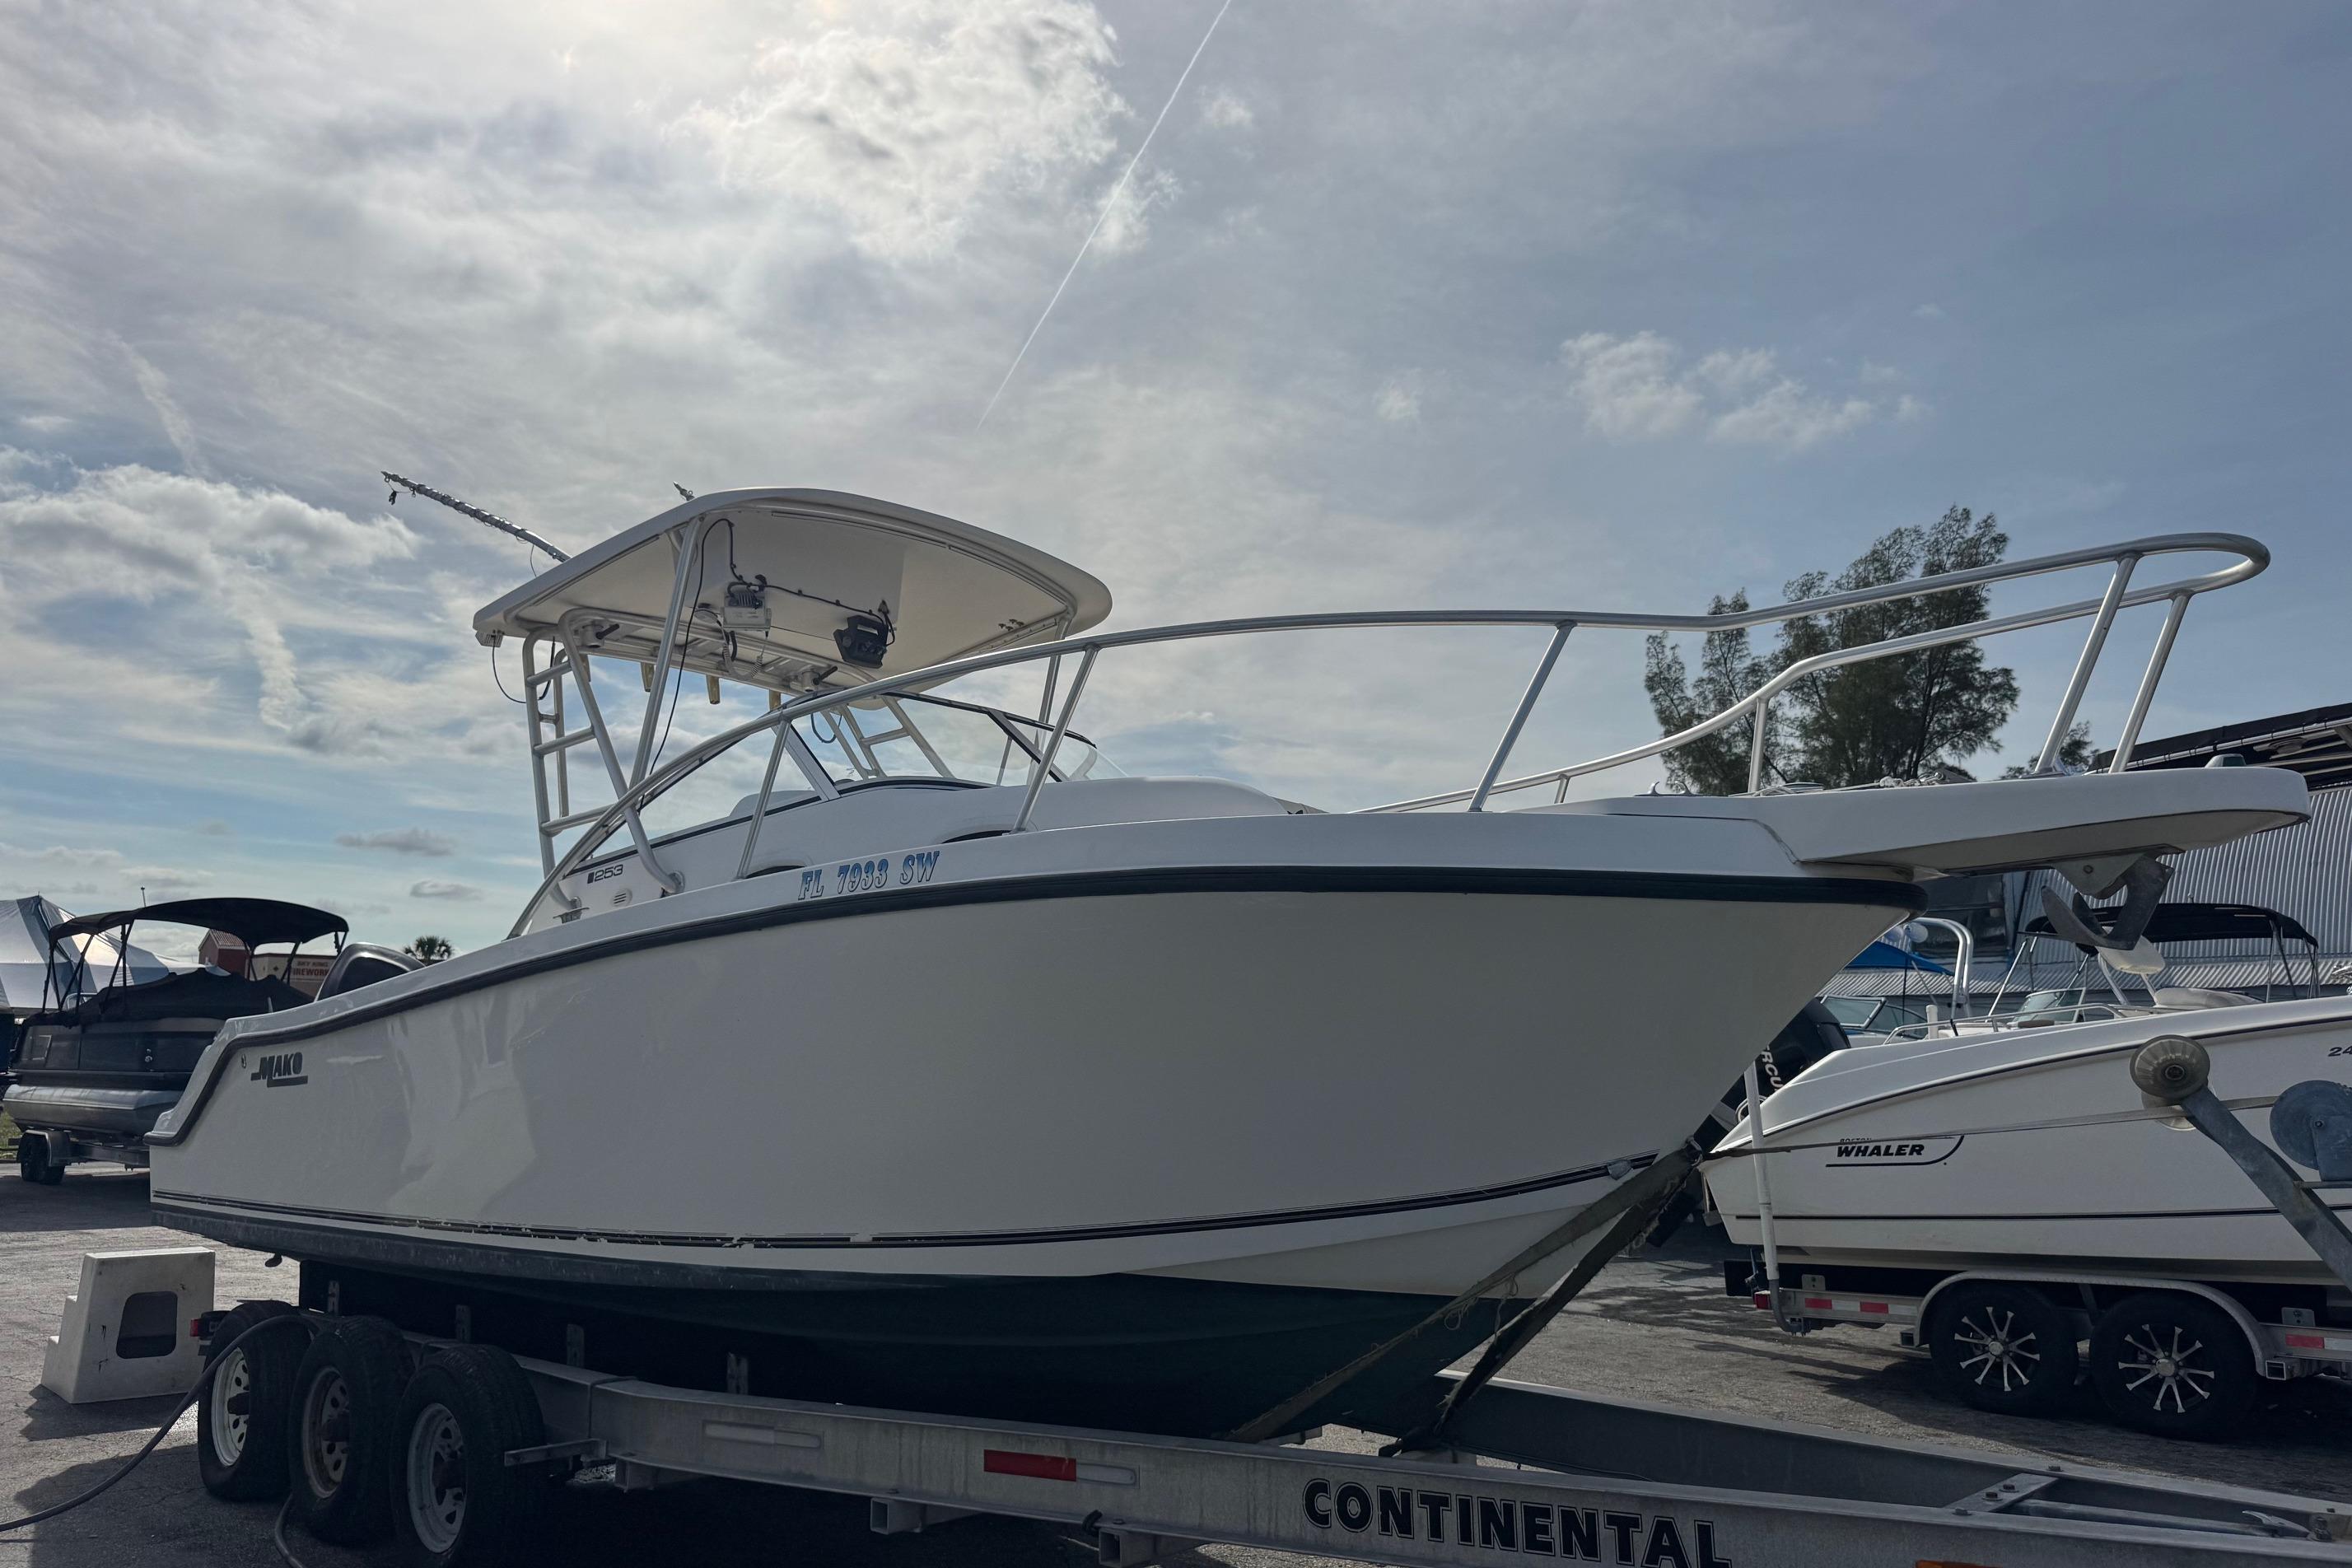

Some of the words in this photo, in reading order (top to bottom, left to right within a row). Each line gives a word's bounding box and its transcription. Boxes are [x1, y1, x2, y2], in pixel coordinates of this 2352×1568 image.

[595, 864, 623, 882] 253
[798, 869, 824, 901] FL
[837, 858, 889, 894] 7933
[899, 850, 940, 885] SW
[292, 968, 329, 976] IREWORK
[251, 1052, 308, 1088] MAKO
[1762, 1044, 1783, 1092] RCU
[1836, 1144, 1925, 1158] WHALER
[1302, 1478, 1732, 1568] CONTINENTAL
